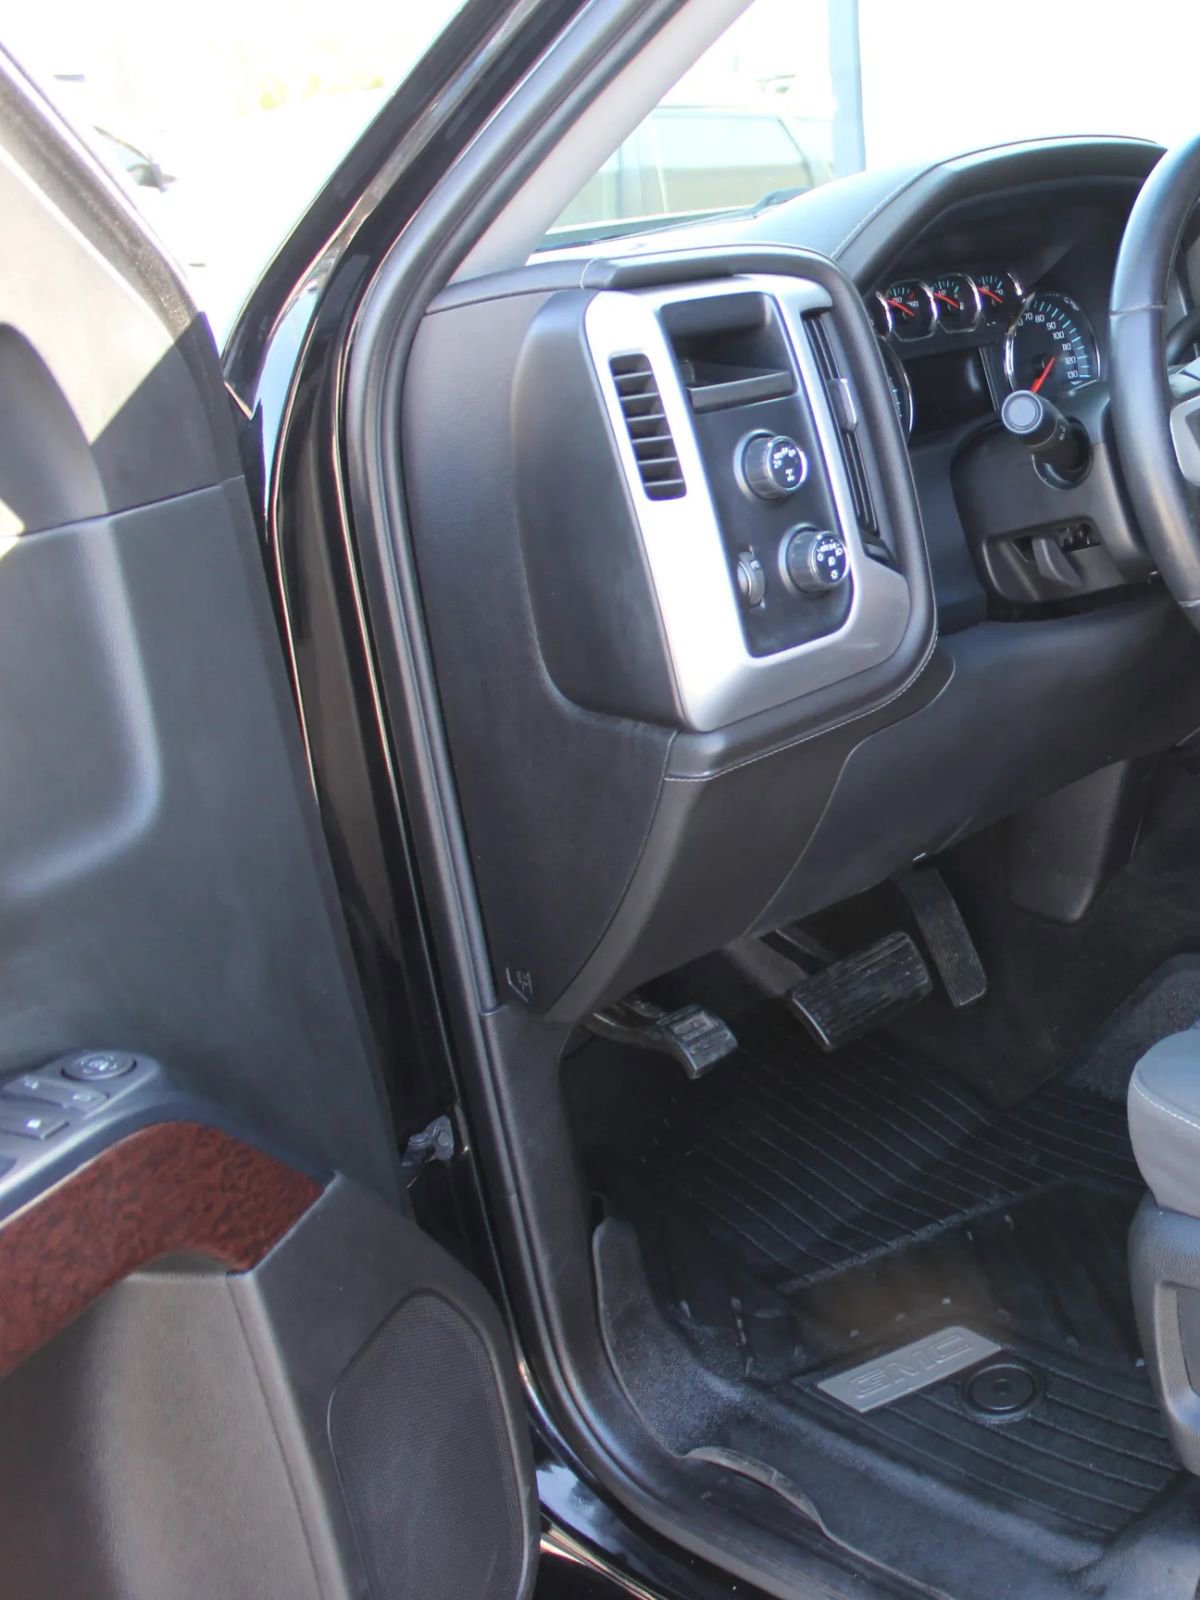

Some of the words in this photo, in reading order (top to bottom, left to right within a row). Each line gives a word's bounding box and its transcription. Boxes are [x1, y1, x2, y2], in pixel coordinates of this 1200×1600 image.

[1024, 312, 1033, 321] 70
[1034, 313, 1045, 323] 80
[1046, 321, 1056, 331] 90
[1052, 330, 1065, 340] 100
[1065, 356, 1076, 365] 120
[1067, 370, 1078, 379] 130
[850, 1333, 974, 1399] GMC
